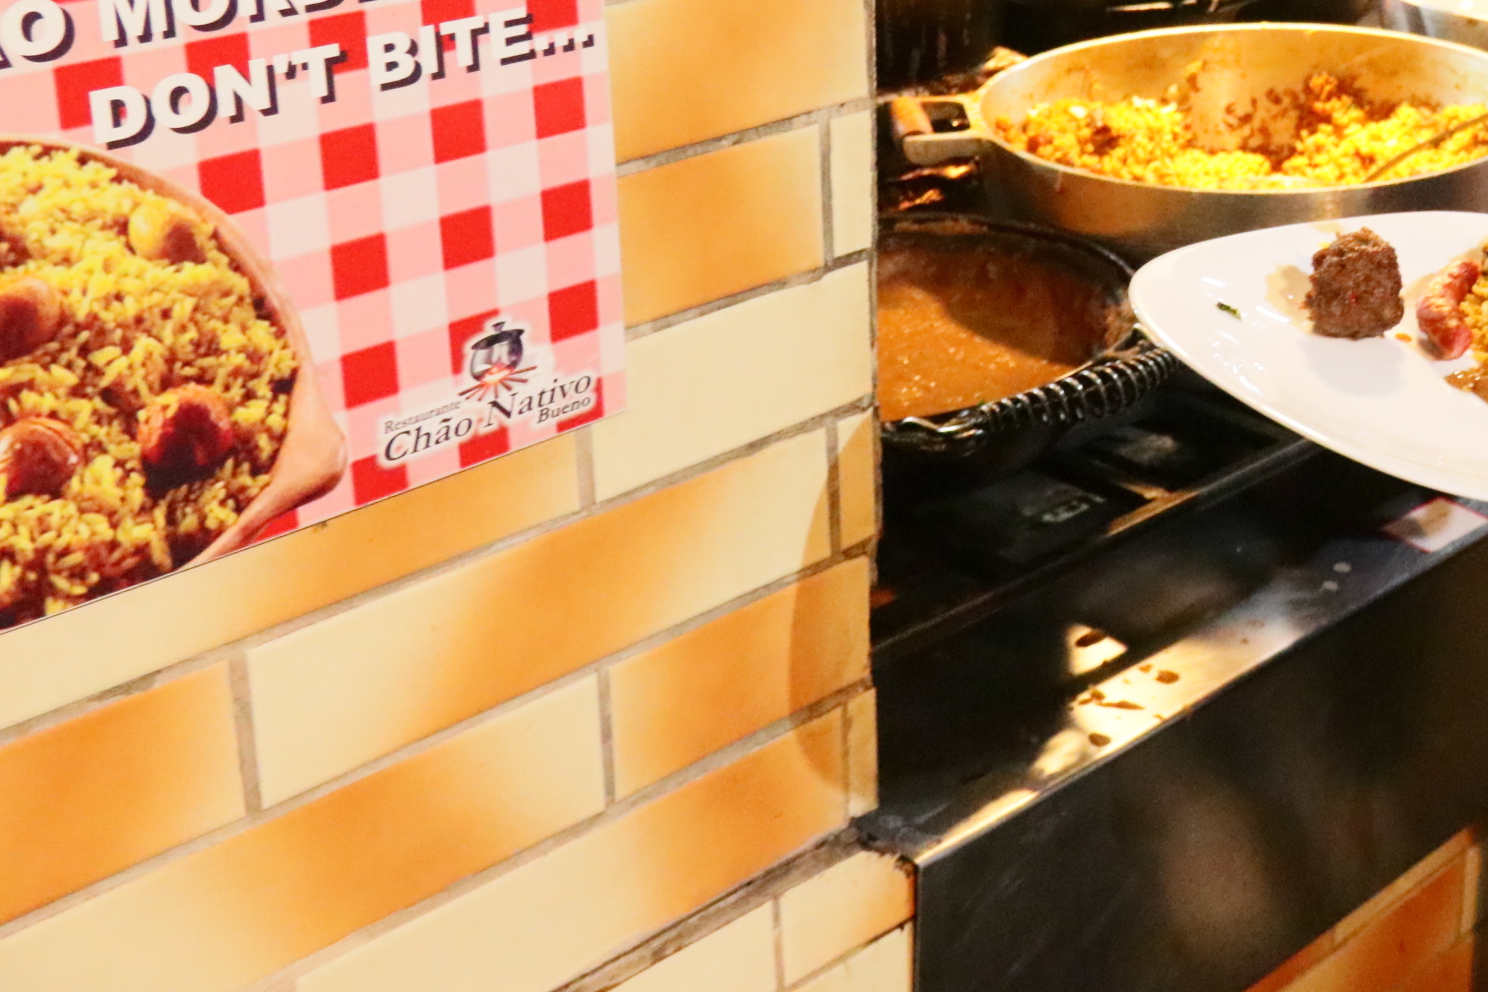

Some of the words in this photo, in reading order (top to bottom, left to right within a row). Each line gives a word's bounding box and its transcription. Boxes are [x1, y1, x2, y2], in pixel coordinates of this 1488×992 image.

[89, 43, 348, 152] DON'T
[366, 8, 595, 93] BITE...
[384, 399, 463, 434] Restaurante
[384, 416, 473, 462] Chão
[484, 375, 592, 428] Nativo
[536, 395, 591, 425] Bueno
